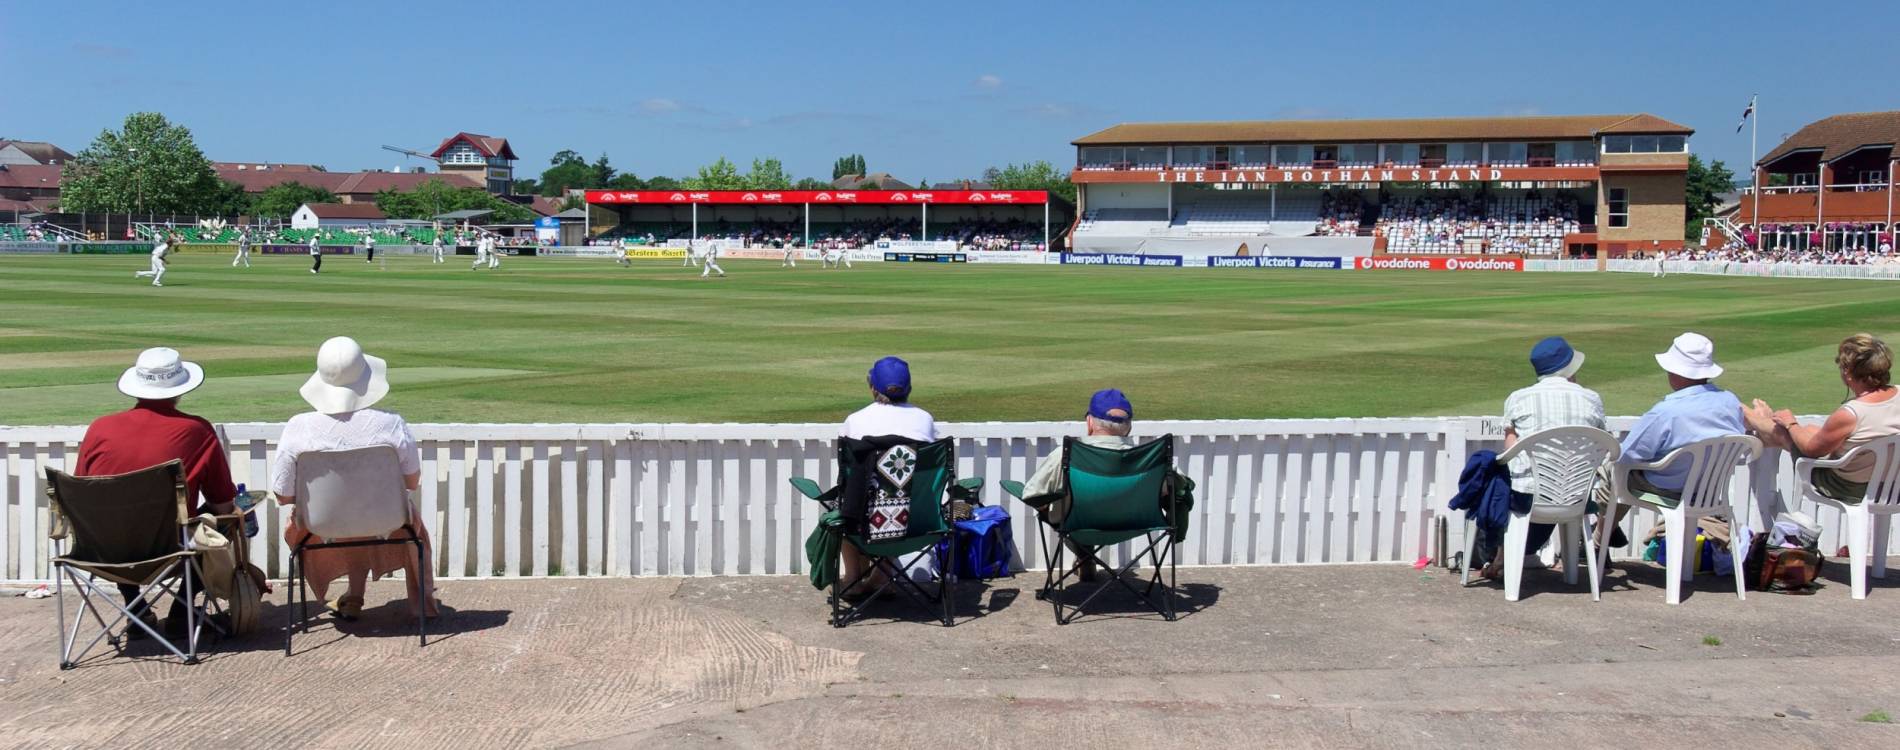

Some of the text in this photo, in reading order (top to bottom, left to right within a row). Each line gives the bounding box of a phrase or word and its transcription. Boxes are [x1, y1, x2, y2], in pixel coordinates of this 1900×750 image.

[1158, 170, 1501, 182] THE IAN BOTHAM STAND
[661, 249, 687, 257] Gazett
[1065, 254, 1177, 266] Liverpool Victoria Insurance
[1213, 257, 1335, 268] Liverpool Victoria Insurance
[1374, 258, 1430, 269] vodafone
[1459, 259, 1515, 270] vodafone
[1481, 420, 1504, 435] Plea
